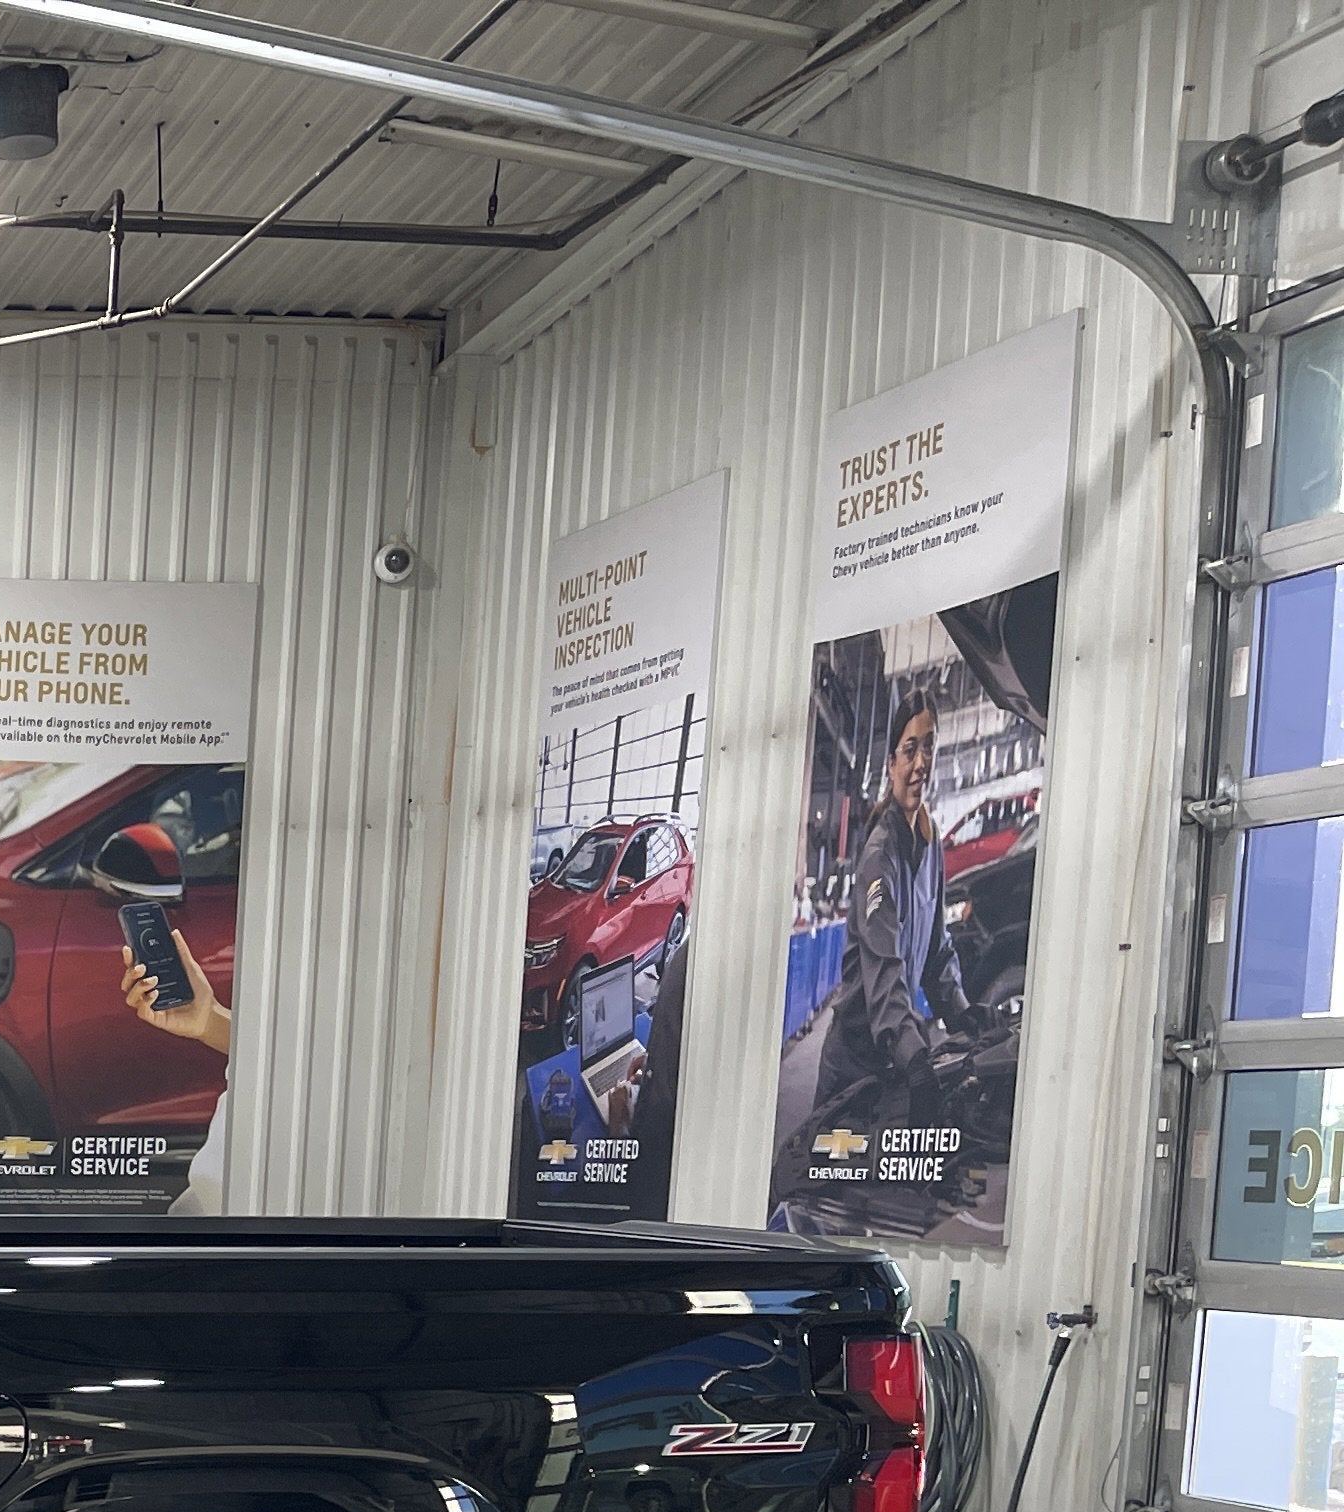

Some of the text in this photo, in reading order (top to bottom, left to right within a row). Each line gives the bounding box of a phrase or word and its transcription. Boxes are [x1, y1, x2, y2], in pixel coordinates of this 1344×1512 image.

[840, 423, 944, 489] TRUST THE
[837, 470, 928, 528] EXPERTS.
[834, 492, 1003, 559] Factory trained technicians know your
[832, 522, 980, 578] Chevy vehicle better than anyone.
[559, 551, 647, 606] MULTI-POINT
[557, 597, 612, 638] VEHICLE
[81, 623, 148, 647] YOUR
[554, 622, 634, 670] INSPECTION
[78, 652, 148, 676] FROM
[38, 681, 130, 705] PHONE.
[46, 716, 111, 731] diagnostics
[114, 718, 134, 729] and
[138, 719, 168, 732] enjoy
[171, 719, 212, 730] remote
[46, 733, 60, 743] on
[63, 732, 82, 743] the
[85, 732, 157, 747] myChevrolet
[160, 734, 196, 744] Mobile
[71, 1136, 167, 1155] CERTIFIED
[585, 1139, 640, 1160] CERTIFIED
[881, 1127, 961, 1153] CERTIFIED
[70, 1158, 149, 1176] SERVICE
[536, 1171, 578, 1182] CHEVROLET
[583, 1163, 628, 1183] SERVICE
[808, 1167, 869, 1180] CHEVROLET
[878, 1157, 944, 1181] SERVICE
[662, 1423, 815, 1456] Z71
